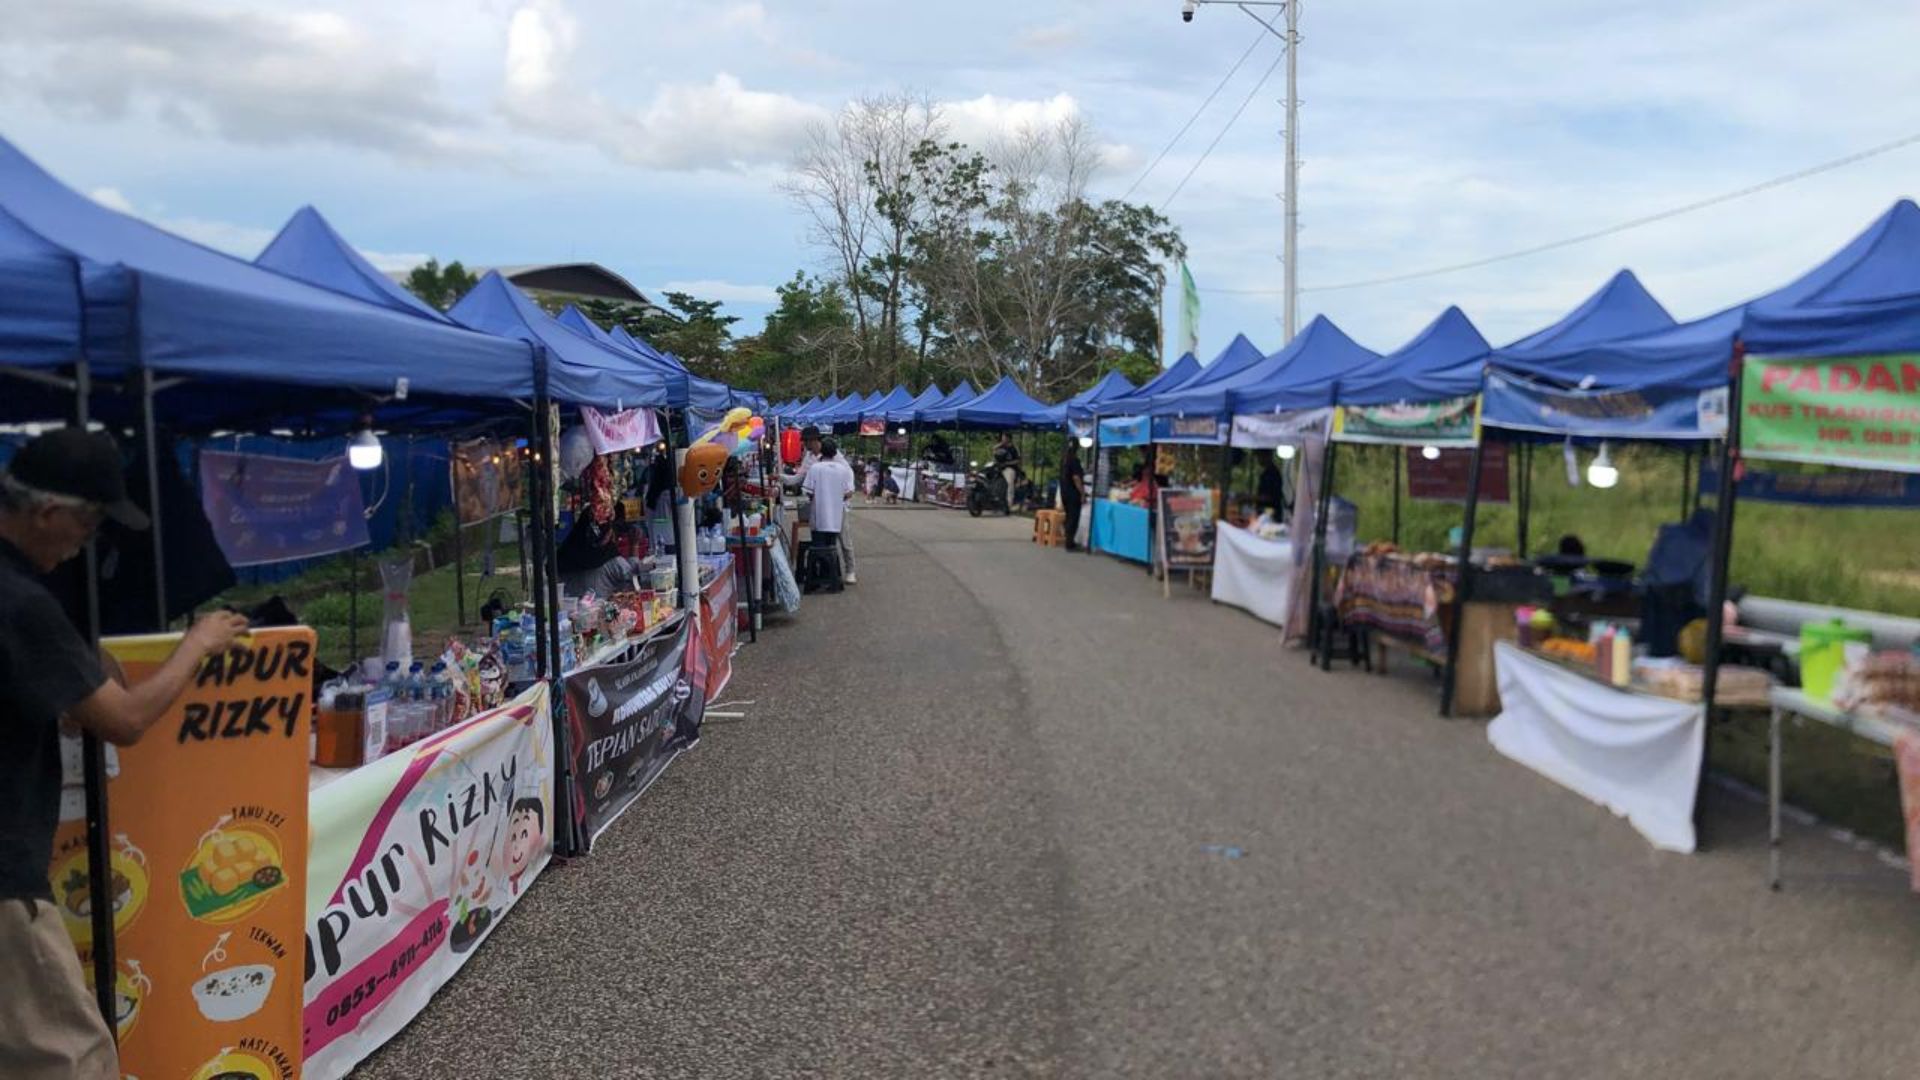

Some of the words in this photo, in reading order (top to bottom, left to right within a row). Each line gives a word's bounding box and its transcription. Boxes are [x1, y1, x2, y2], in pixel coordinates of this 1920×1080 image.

[197, 641, 310, 687] APUR
[177, 693, 304, 744] RIZKY
[304, 843, 404, 984] pur
[250, 926, 287, 960] TEKWAN
[239, 1037, 270, 1053] NASI
